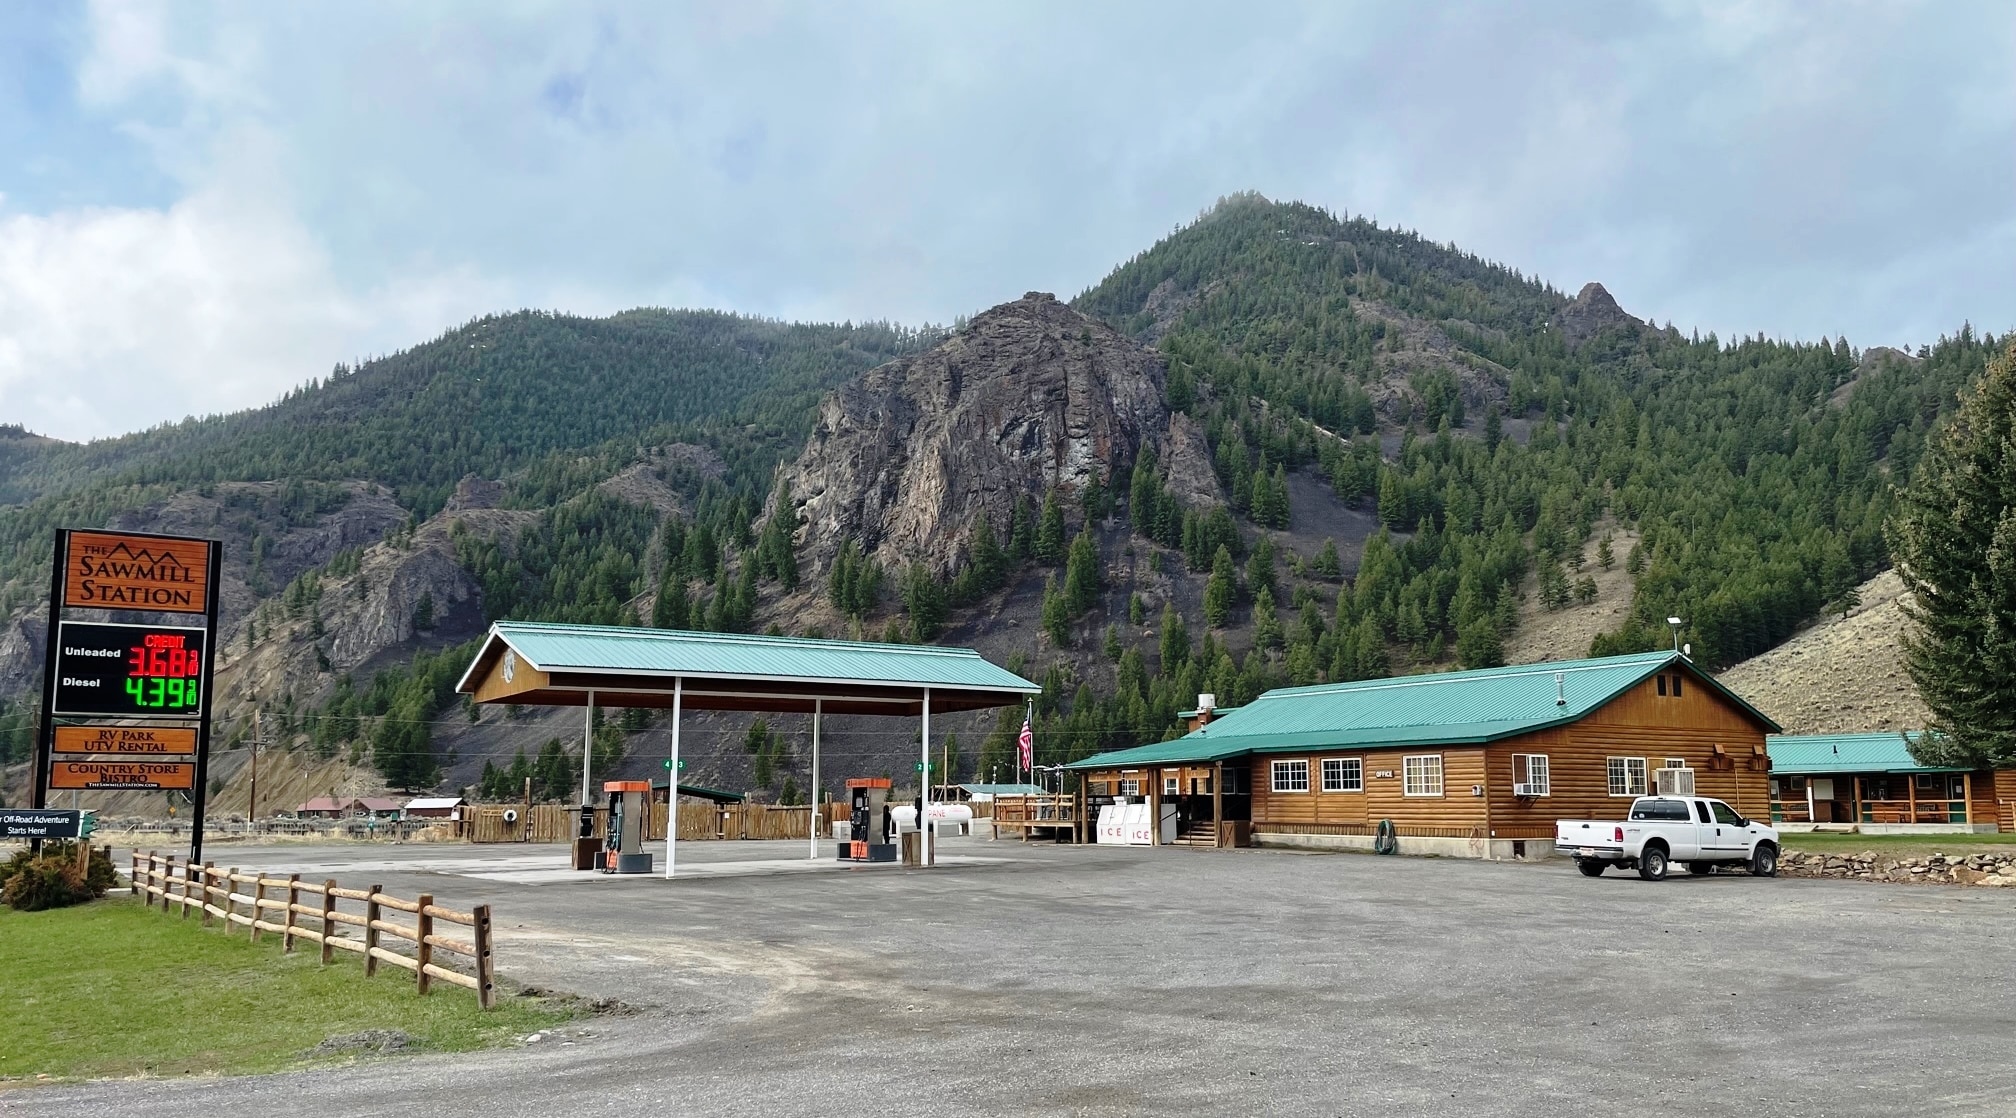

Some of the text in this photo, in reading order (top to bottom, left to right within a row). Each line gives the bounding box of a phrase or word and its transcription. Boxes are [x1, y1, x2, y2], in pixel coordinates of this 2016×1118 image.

[83, 545, 107, 555] THE
[80, 555, 195, 583] SAWMILL
[80, 579, 191, 606] STATION
[144, 634, 186, 648] CREDIT
[65, 647, 121, 658] Unleaded
[129, 647, 186, 677] 3.68
[63, 678, 100, 687] Diesel
[126, 677, 184, 707] 4.39
[100, 730, 155, 741] RV PARK
[84, 741, 168, 752] UTV RENTAL
[68, 763, 180, 774] COUNTRY STORE
[100, 773, 148, 783] BISTRO
[3, 815, 34, 824] Off-Road
[33, 815, 70, 824] Adventure
[7, 826, 47, 835] Starts Here!
[1100, 828, 1122, 837] ICE
[1132, 831, 1149, 840] ICE
